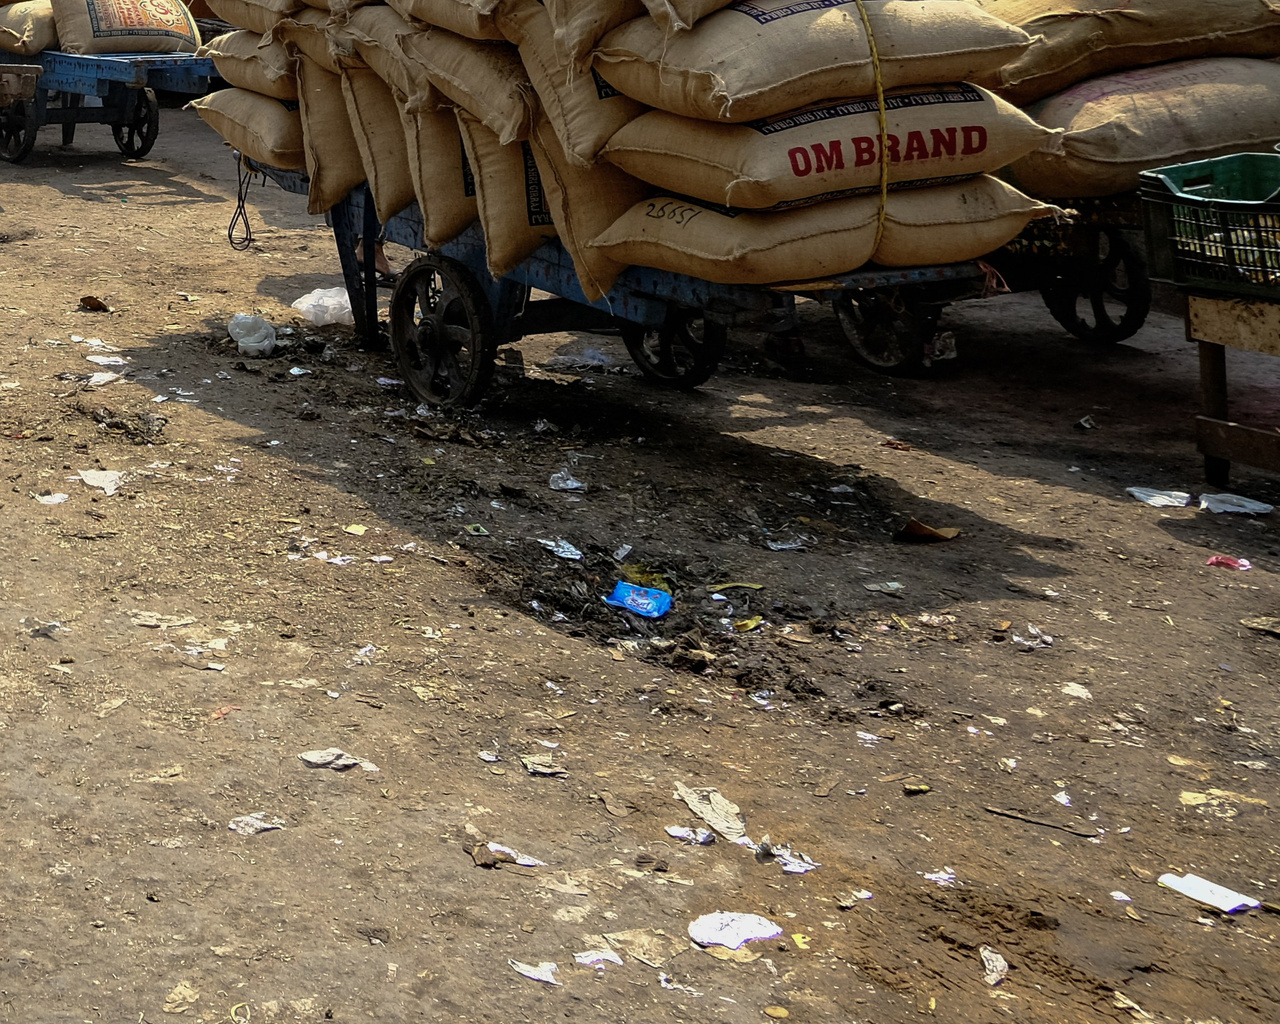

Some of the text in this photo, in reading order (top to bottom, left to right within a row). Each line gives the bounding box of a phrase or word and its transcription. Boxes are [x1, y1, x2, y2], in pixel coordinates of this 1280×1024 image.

[791, 3, 809, 13] SHRI
[810, 0, 823, 10] JAI
[758, 6, 790, 23] GIRRAJ
[911, 95, 944, 105] GIRRAJ
[946, 93, 967, 103] SHRI
[968, 92, 980, 101] JAI
[887, 97, 903, 108] JAI
[817, 109, 829, 119] JAI
[837, 103, 867, 116] GIRRAJ
[796, 113, 817, 125] SHRI
[764, 118, 795, 134] GIRRAJ
[788, 126, 988, 178] OM BRAND
[528, 168, 538, 184] SHRI
[529, 186, 541, 211] GIRRAJ
[532, 214, 549, 224] RAJ
